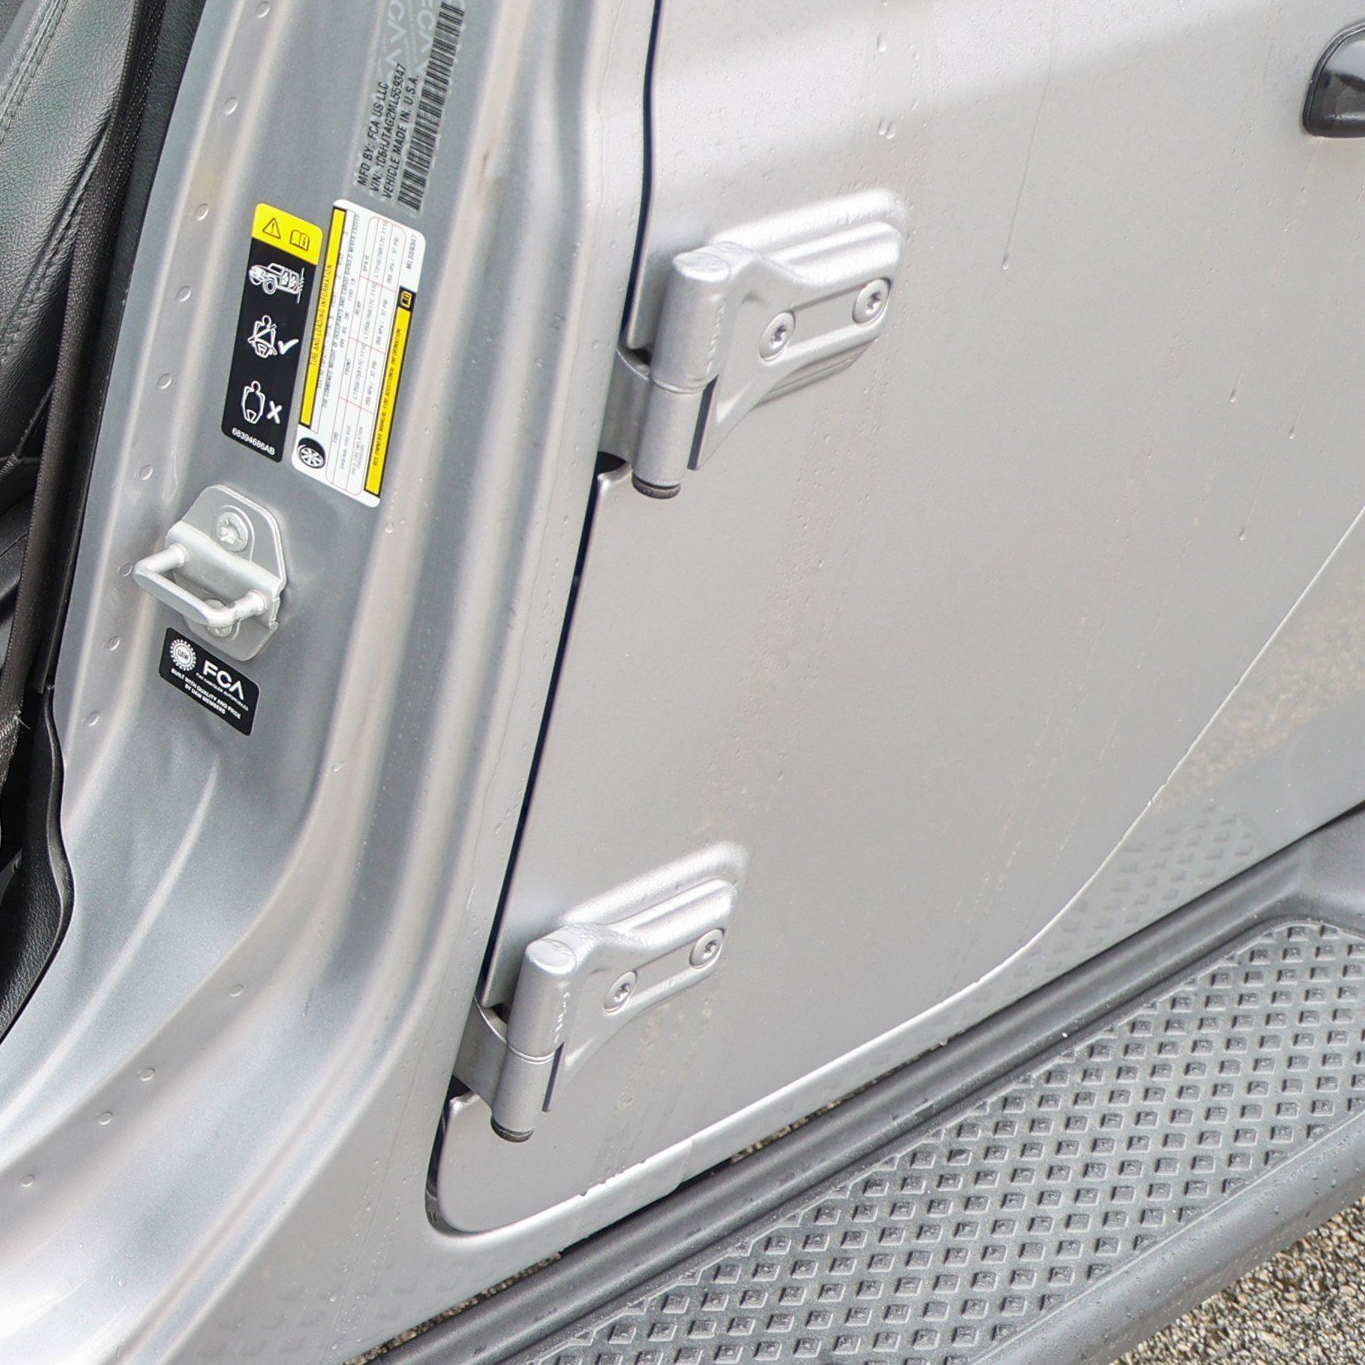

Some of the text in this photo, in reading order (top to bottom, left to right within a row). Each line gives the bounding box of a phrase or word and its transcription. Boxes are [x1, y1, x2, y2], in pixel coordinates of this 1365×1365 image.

[375, 81, 388, 101] LLC
[367, 119, 380, 140] FCA
[383, 73, 419, 199] VEHICLE MADE IN: U.S.A.
[363, 142, 375, 161] BY:
[358, 162, 371, 186] MFD
[370, 171, 383, 193] VIN:
[203, 660, 244, 700] FCA
[171, 668, 241, 719] BUILT WITH QUALITY AND PRIDE
[202, 695, 225, 714] MEMBERS
